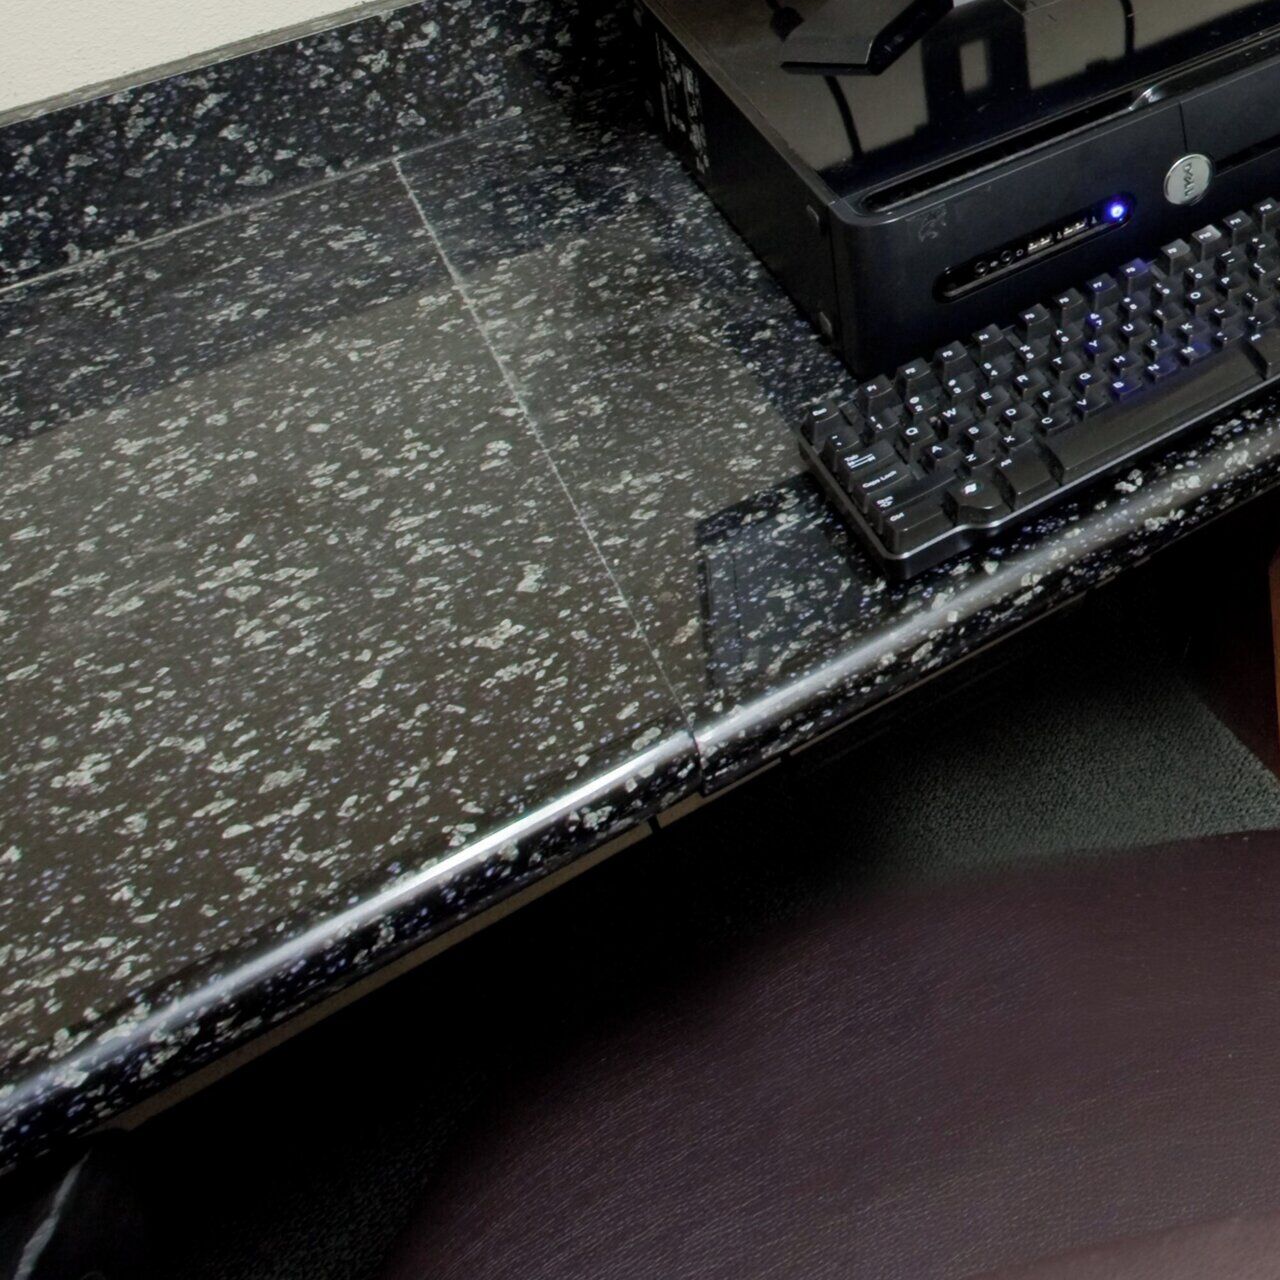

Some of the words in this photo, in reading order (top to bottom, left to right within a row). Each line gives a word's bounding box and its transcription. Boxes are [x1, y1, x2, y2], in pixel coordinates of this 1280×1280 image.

[1184, 162, 1194, 197] DELL
[1122, 323, 1134, 332] U
[1181, 322, 1193, 330] K
[1088, 339, 1098, 348] Y
[1181, 345, 1195, 354] M
[1148, 363, 1160, 372] N
[981, 392, 992, 401] E
[1077, 398, 1087, 406] V
[942, 407, 957, 418] W
[1041, 417, 1054, 425] C
[905, 426, 919, 436] Q
[1003, 434, 1016, 443] X
[965, 453, 977, 463] Z
